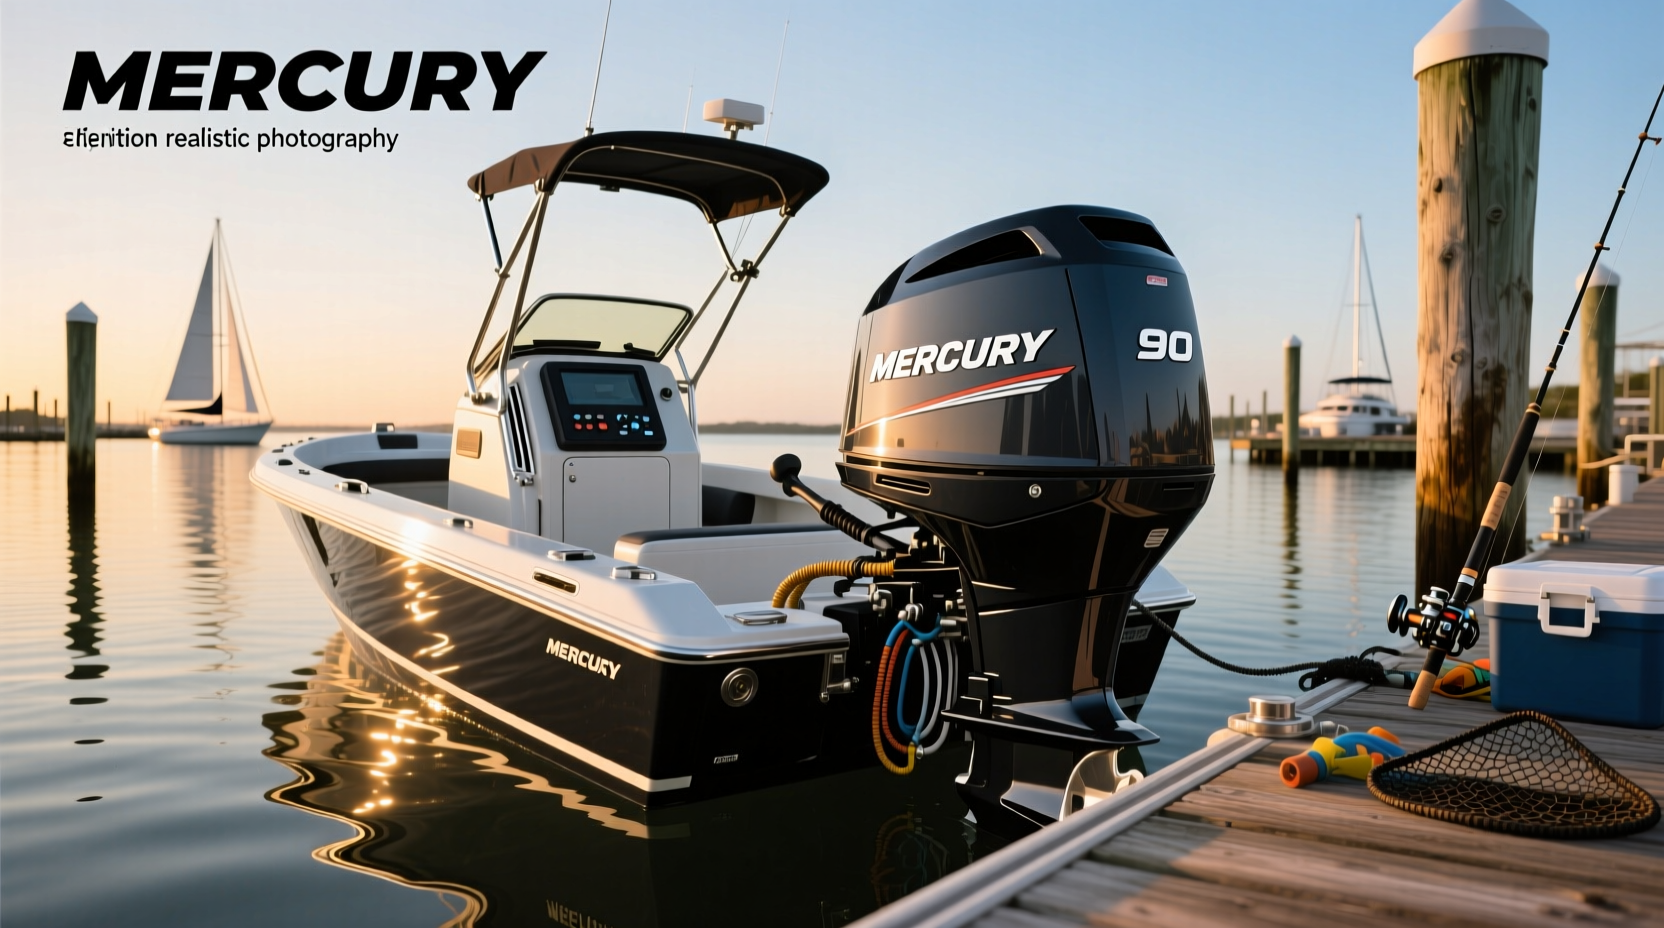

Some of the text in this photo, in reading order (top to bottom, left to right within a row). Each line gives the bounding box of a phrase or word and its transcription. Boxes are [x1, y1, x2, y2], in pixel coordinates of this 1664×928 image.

[870, 329, 1055, 382] MERCURY
[1137, 328, 1194, 363] 90
[546, 638, 621, 680] MERCURY
